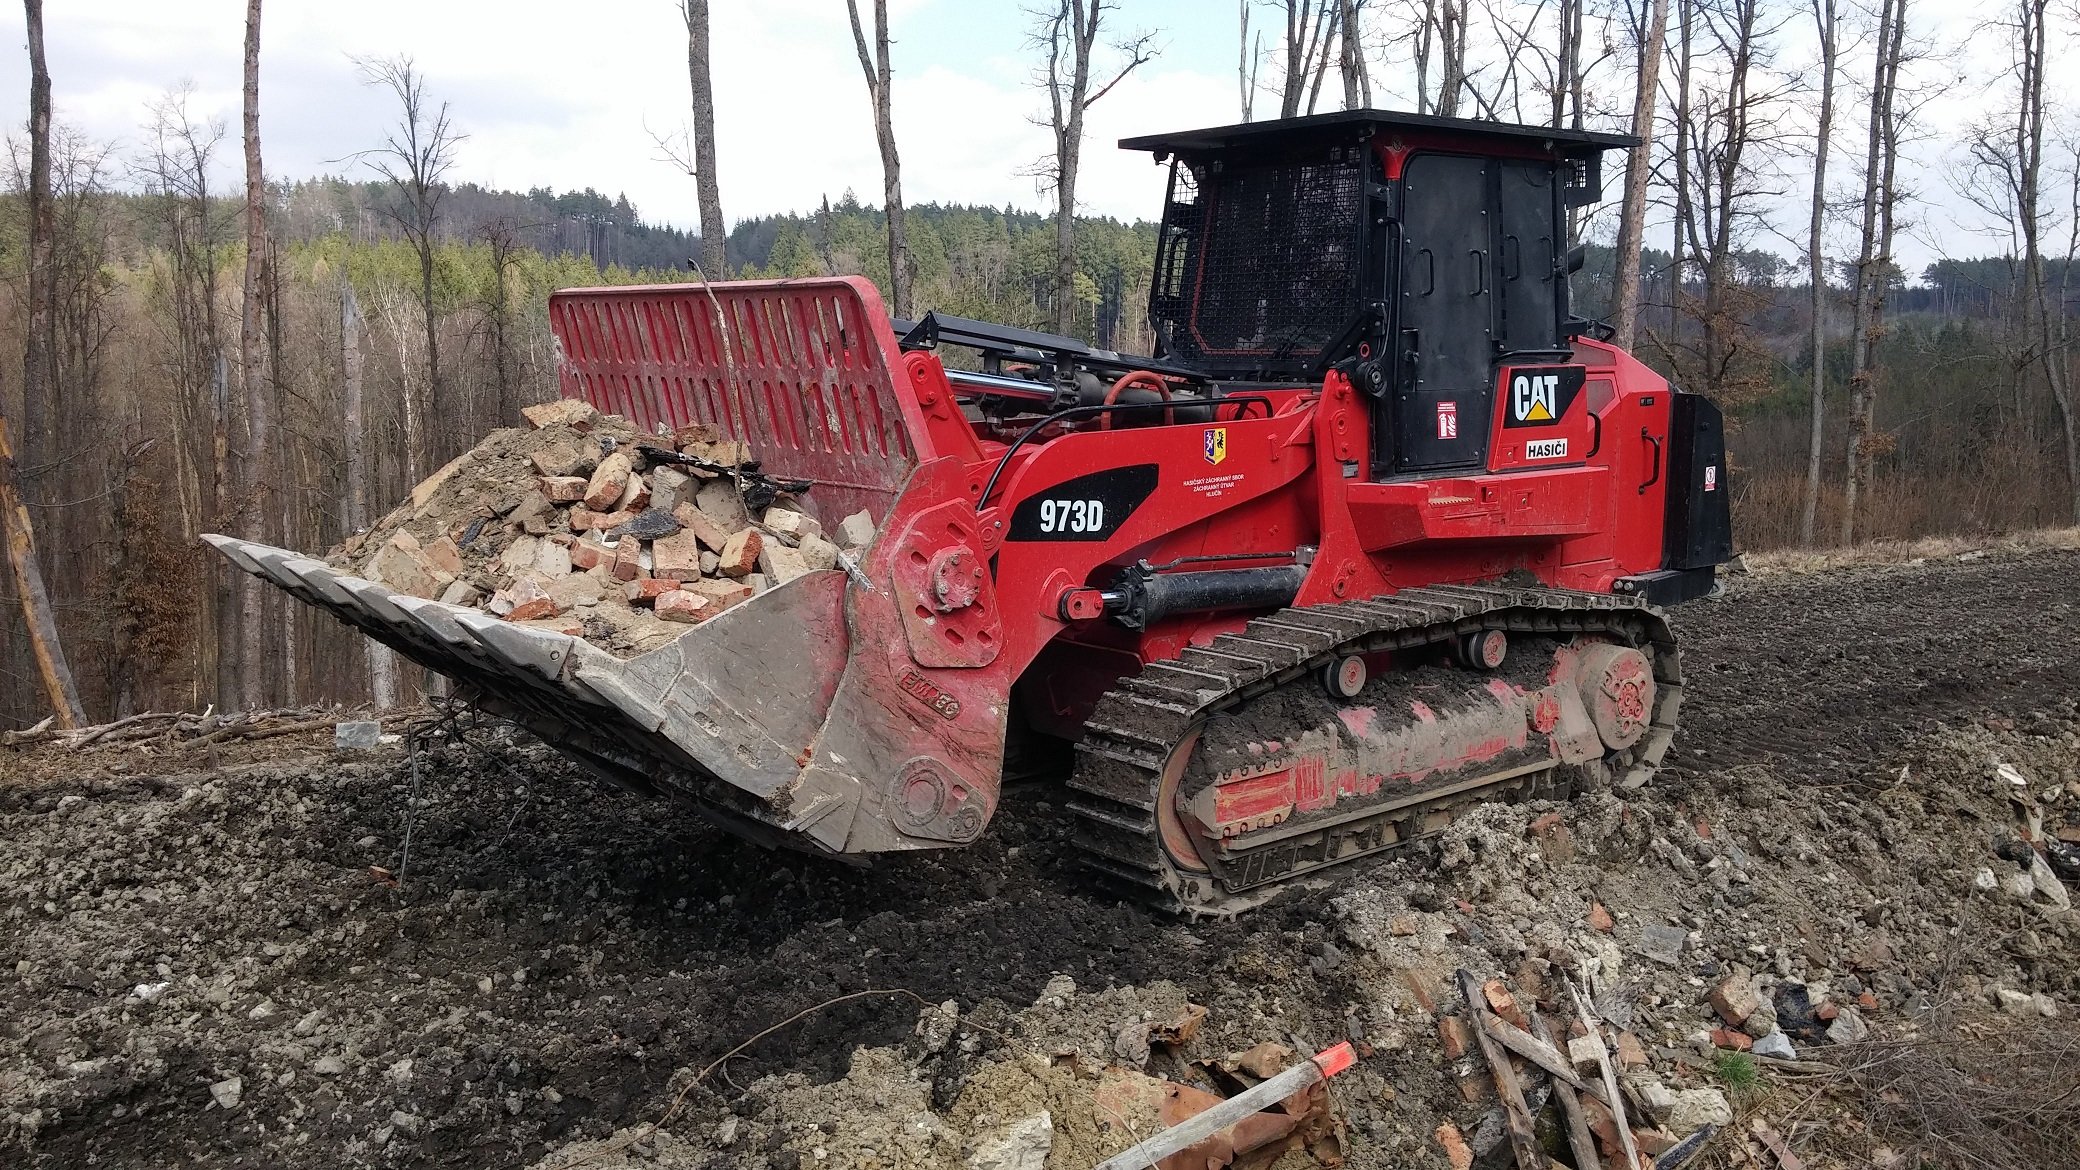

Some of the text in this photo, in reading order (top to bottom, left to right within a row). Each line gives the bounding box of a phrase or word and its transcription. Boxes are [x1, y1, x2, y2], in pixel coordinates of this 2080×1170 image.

[1514, 375, 1558, 421] CAT
[1528, 440, 1566, 457] HASIČI
[1040, 499, 1104, 533] 973D
